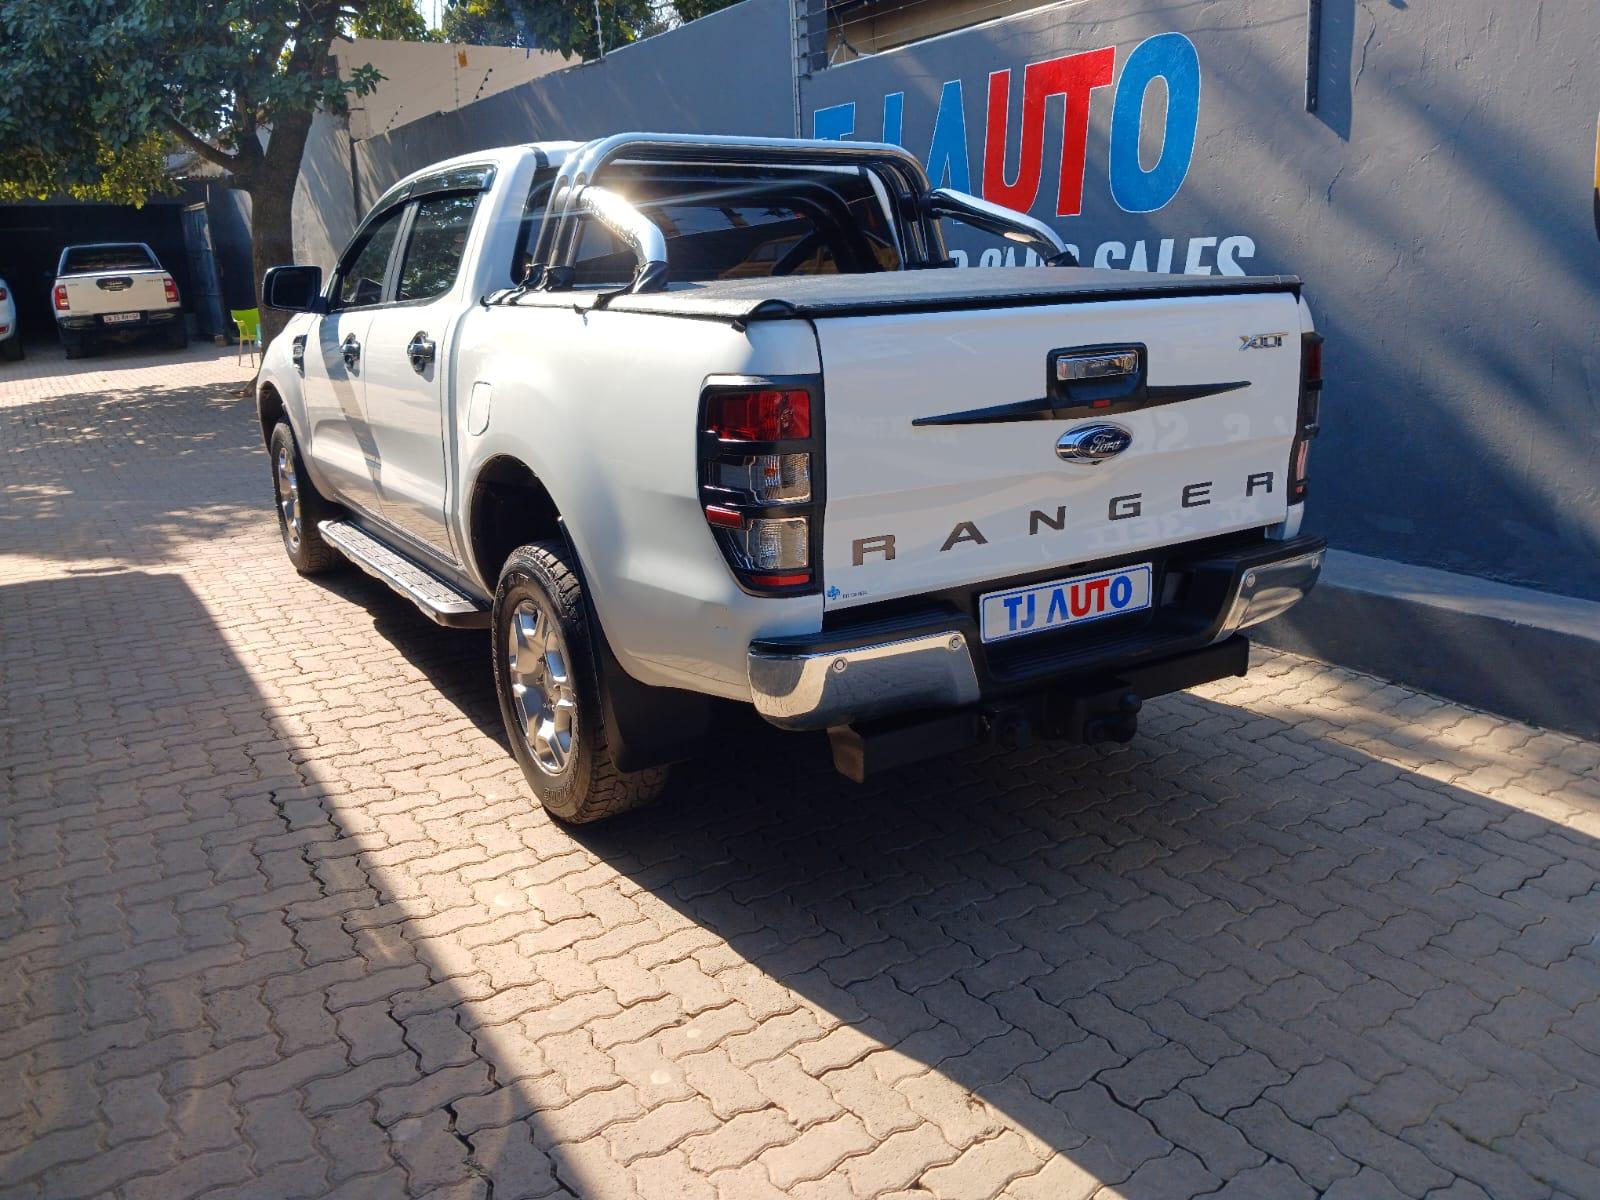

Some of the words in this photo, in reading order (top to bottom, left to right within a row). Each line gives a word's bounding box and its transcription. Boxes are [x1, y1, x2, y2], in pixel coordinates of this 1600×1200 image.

[925, 31, 1202, 224] AUTO
[1239, 332, 1288, 351] XLT
[852, 471, 1274, 566] RANGER
[1004, 594, 1035, 631] TJ
[1047, 575, 1133, 624] AUTO
